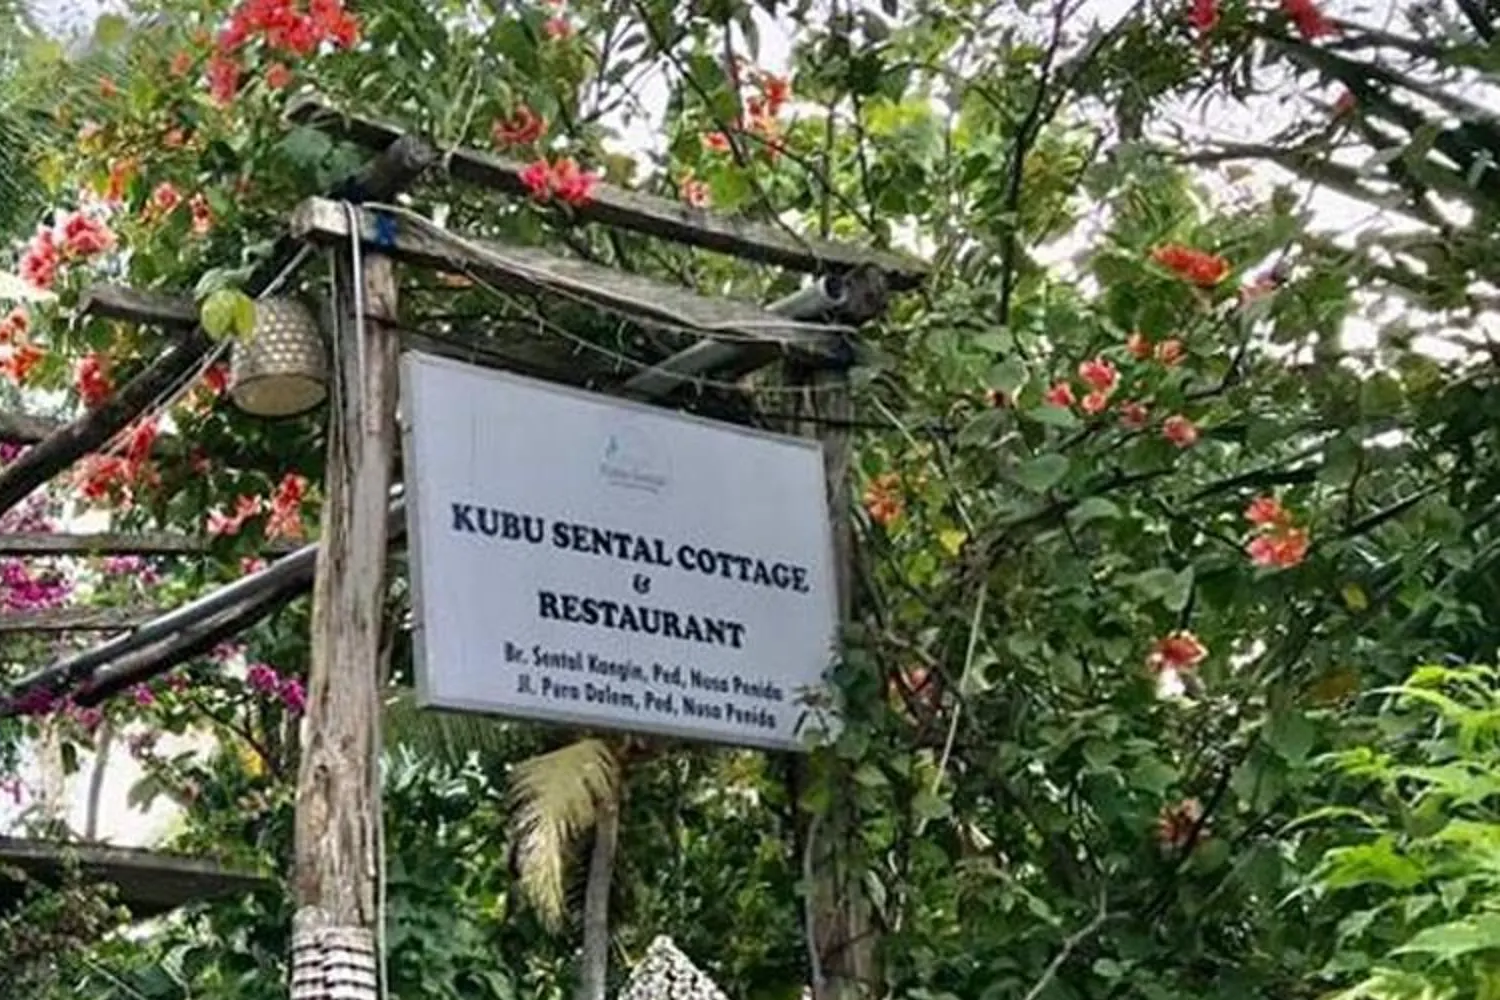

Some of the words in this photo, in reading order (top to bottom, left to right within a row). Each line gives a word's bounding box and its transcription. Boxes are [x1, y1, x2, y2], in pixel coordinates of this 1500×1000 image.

[452, 503, 544, 543] KUBU
[552, 521, 673, 567] SENTAL
[677, 545, 809, 594] COTTAGE
[632, 573, 651, 594] &
[538, 590, 745, 648] RESTAURANT
[532, 645, 583, 672] Sental
[690, 668, 729, 693] Nusa
[733, 674, 783, 701] Penida
[541, 676, 580, 700] Pura
[682, 696, 722, 720] Nusa
[726, 702, 776, 729] Penida
